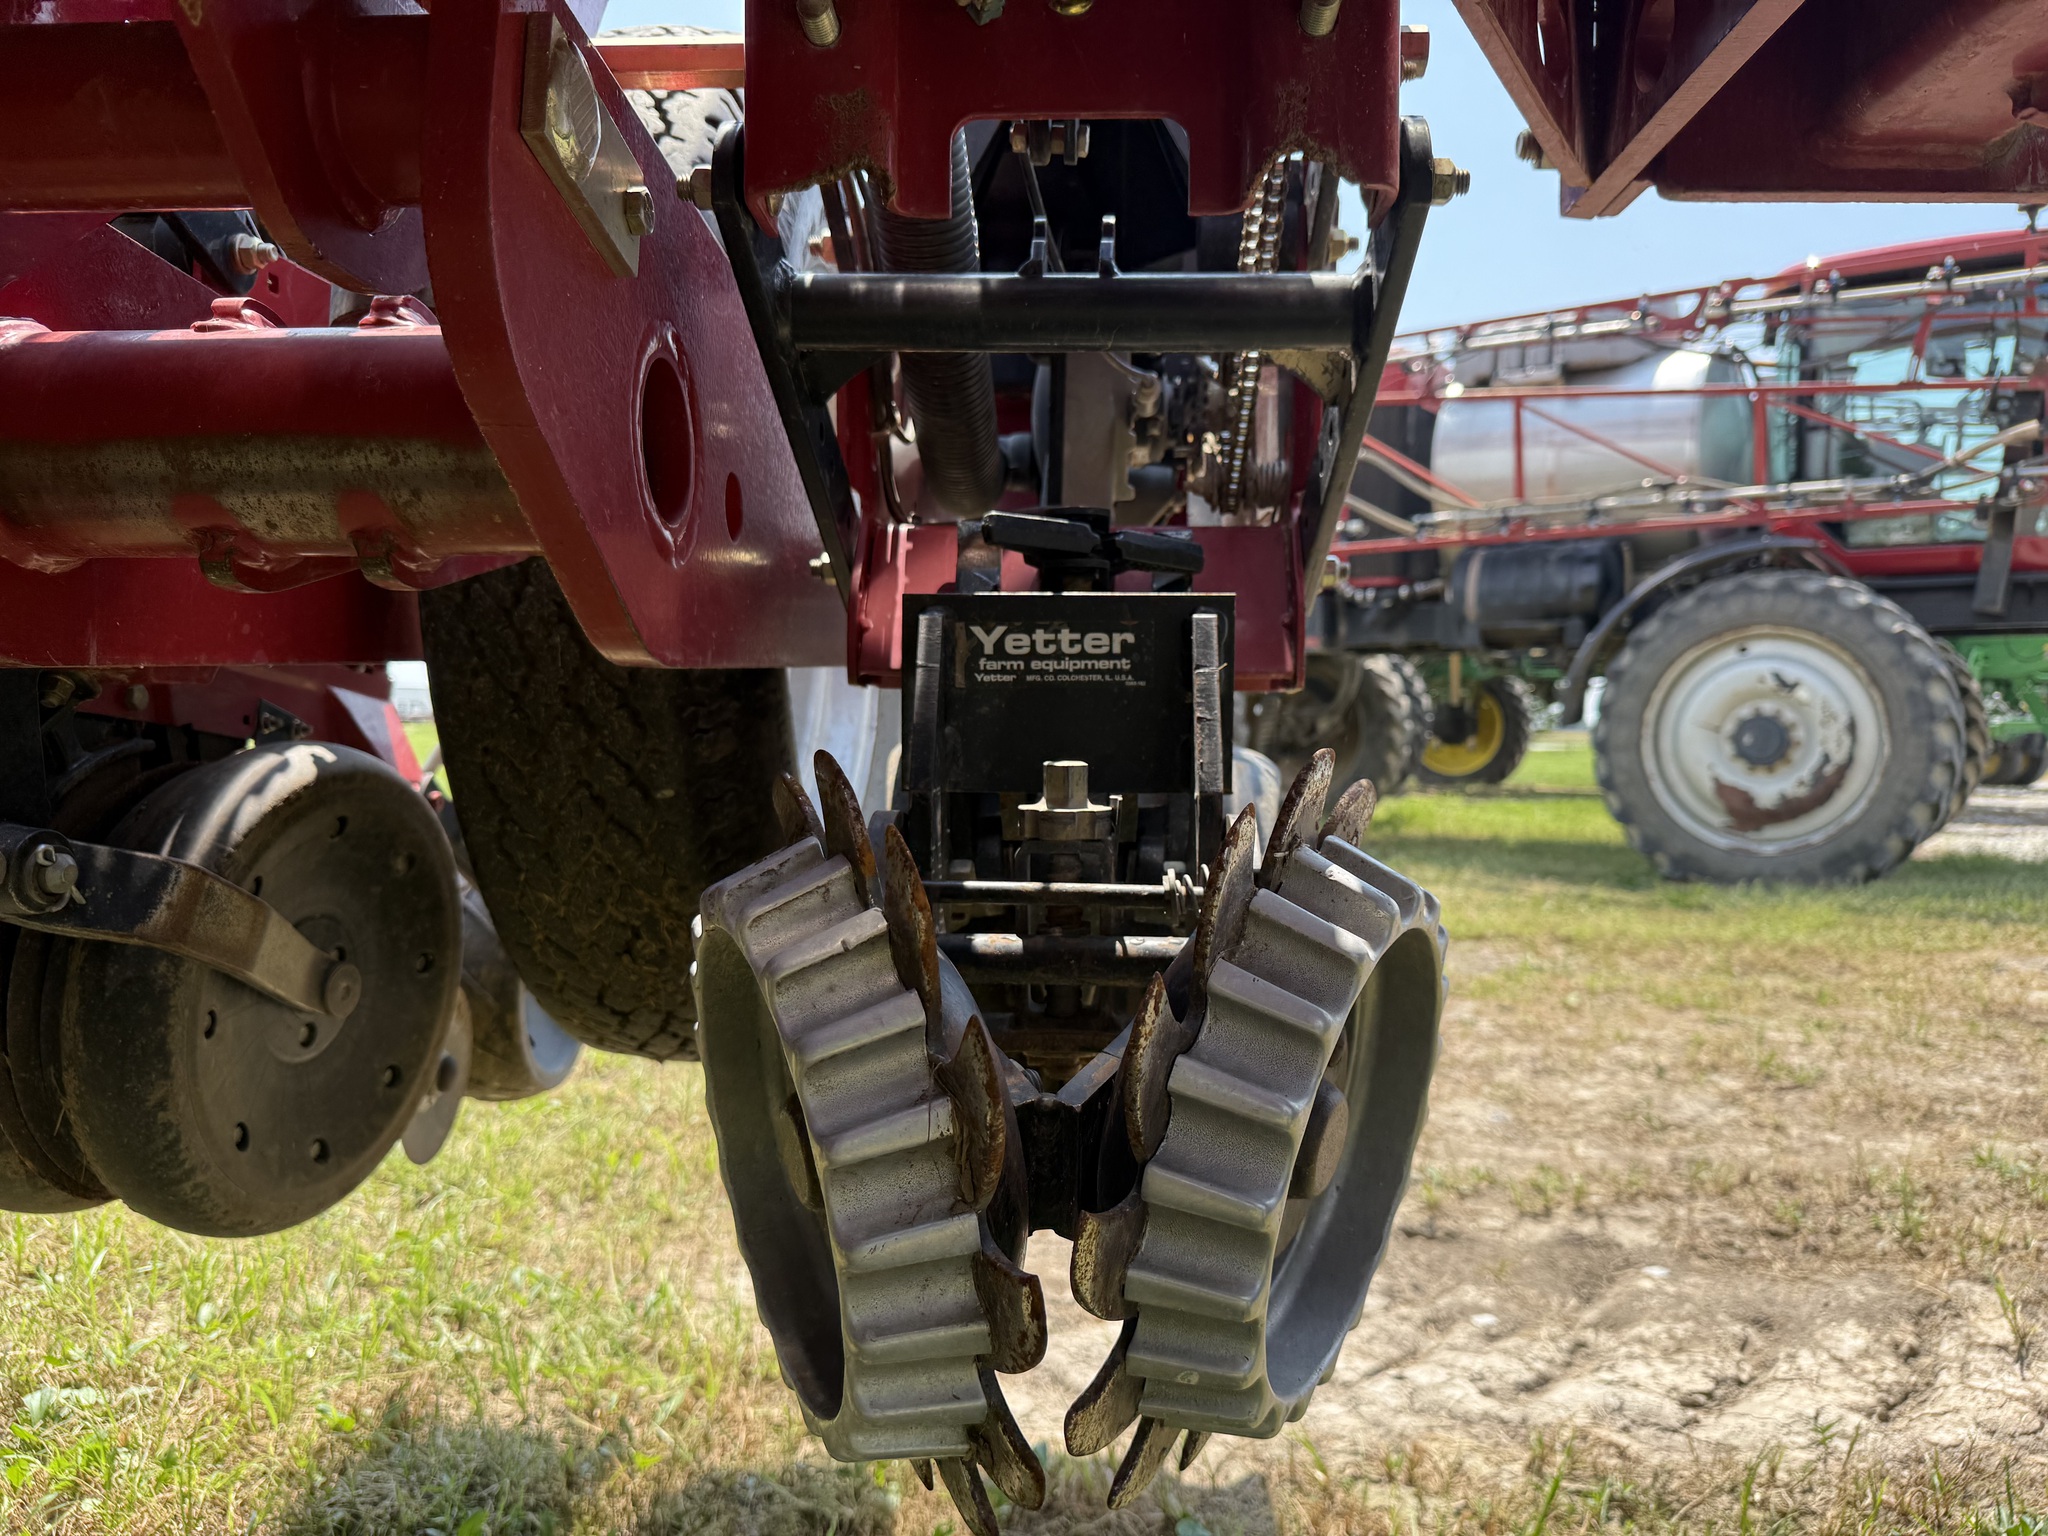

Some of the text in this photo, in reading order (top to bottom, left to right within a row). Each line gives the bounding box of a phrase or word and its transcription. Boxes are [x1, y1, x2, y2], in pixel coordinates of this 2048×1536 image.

[969, 625, 1136, 655] Yetter
[979, 657, 1131, 672] farm equipment
[974, 673, 1017, 682] Yetter
[1044, 674, 1056, 682] CO.
[1057, 674, 1104, 682] COLCHESTER,
